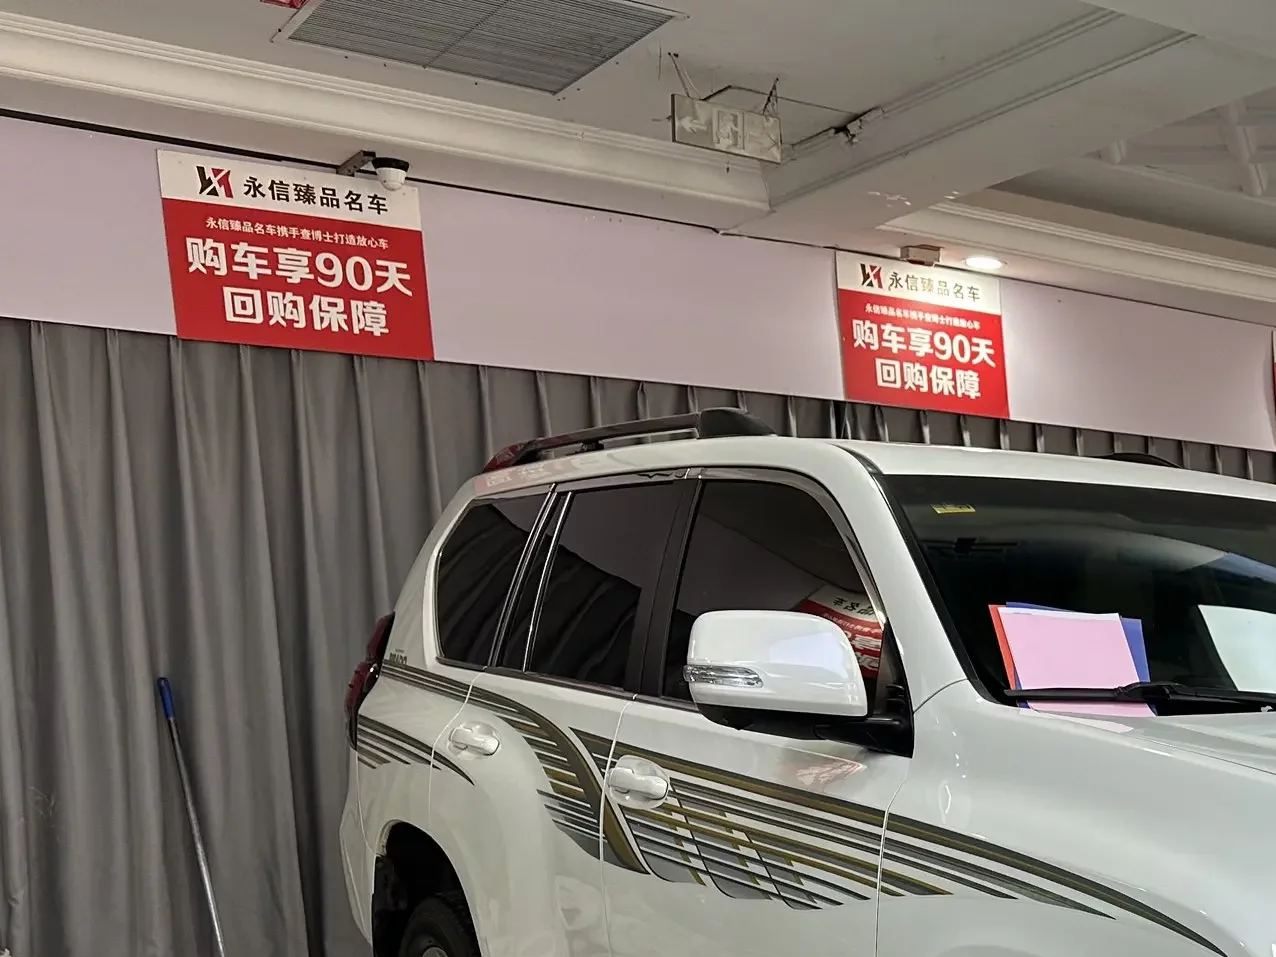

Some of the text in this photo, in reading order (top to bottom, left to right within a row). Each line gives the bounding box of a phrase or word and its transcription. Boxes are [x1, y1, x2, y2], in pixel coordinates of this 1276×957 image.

[243, 176, 388, 215] 永信臻品名车
[206, 217, 390, 250] 永信臻品名车携手查博士打造放心车
[186, 237, 413, 297] 购车享90天
[888, 271, 980, 301] 永信臻品名车
[222, 286, 390, 336] 回购保障
[852, 319, 996, 367] 购车享90天
[875, 358, 981, 399] 回购保障
